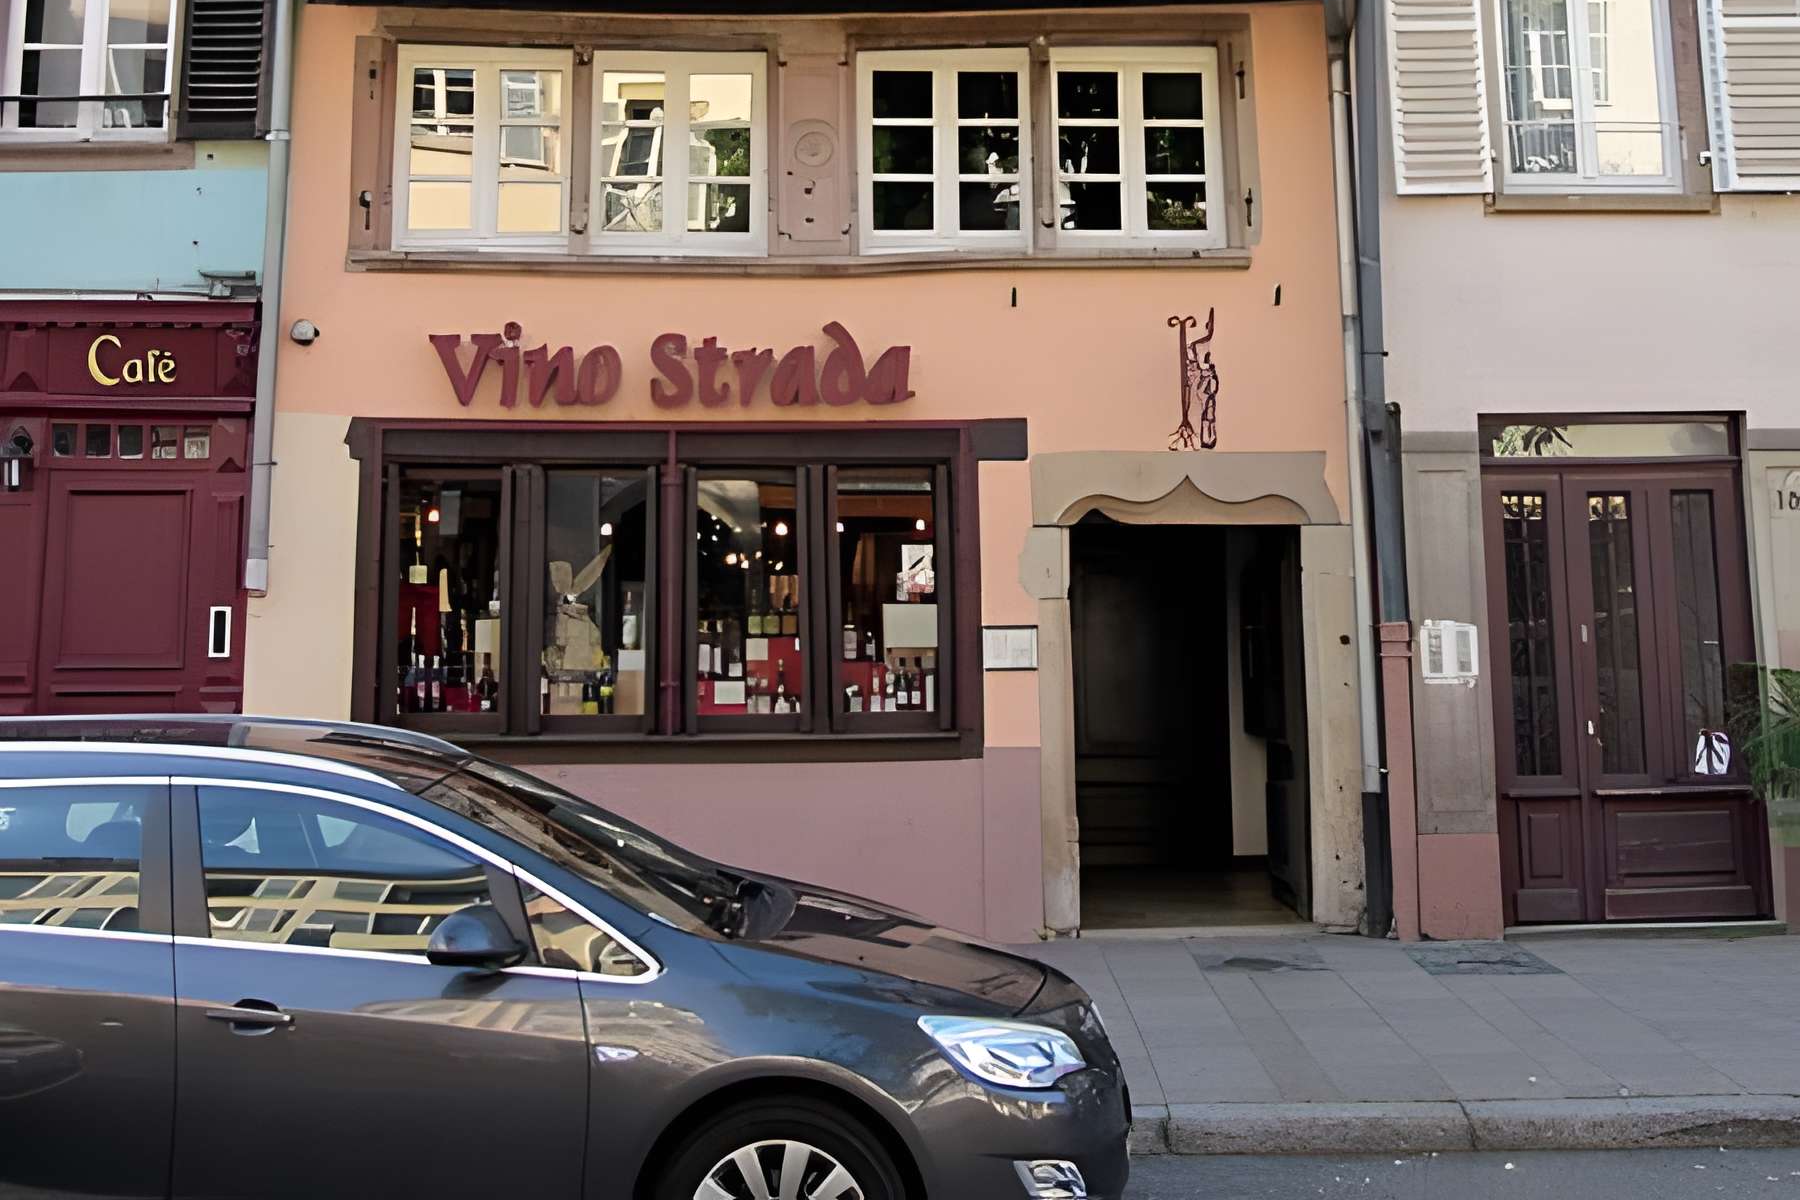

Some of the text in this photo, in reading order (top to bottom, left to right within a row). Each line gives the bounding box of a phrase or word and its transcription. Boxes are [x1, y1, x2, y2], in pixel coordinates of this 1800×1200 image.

[88, 334, 177, 386] Café
[428, 321, 916, 409] Vino Strada
